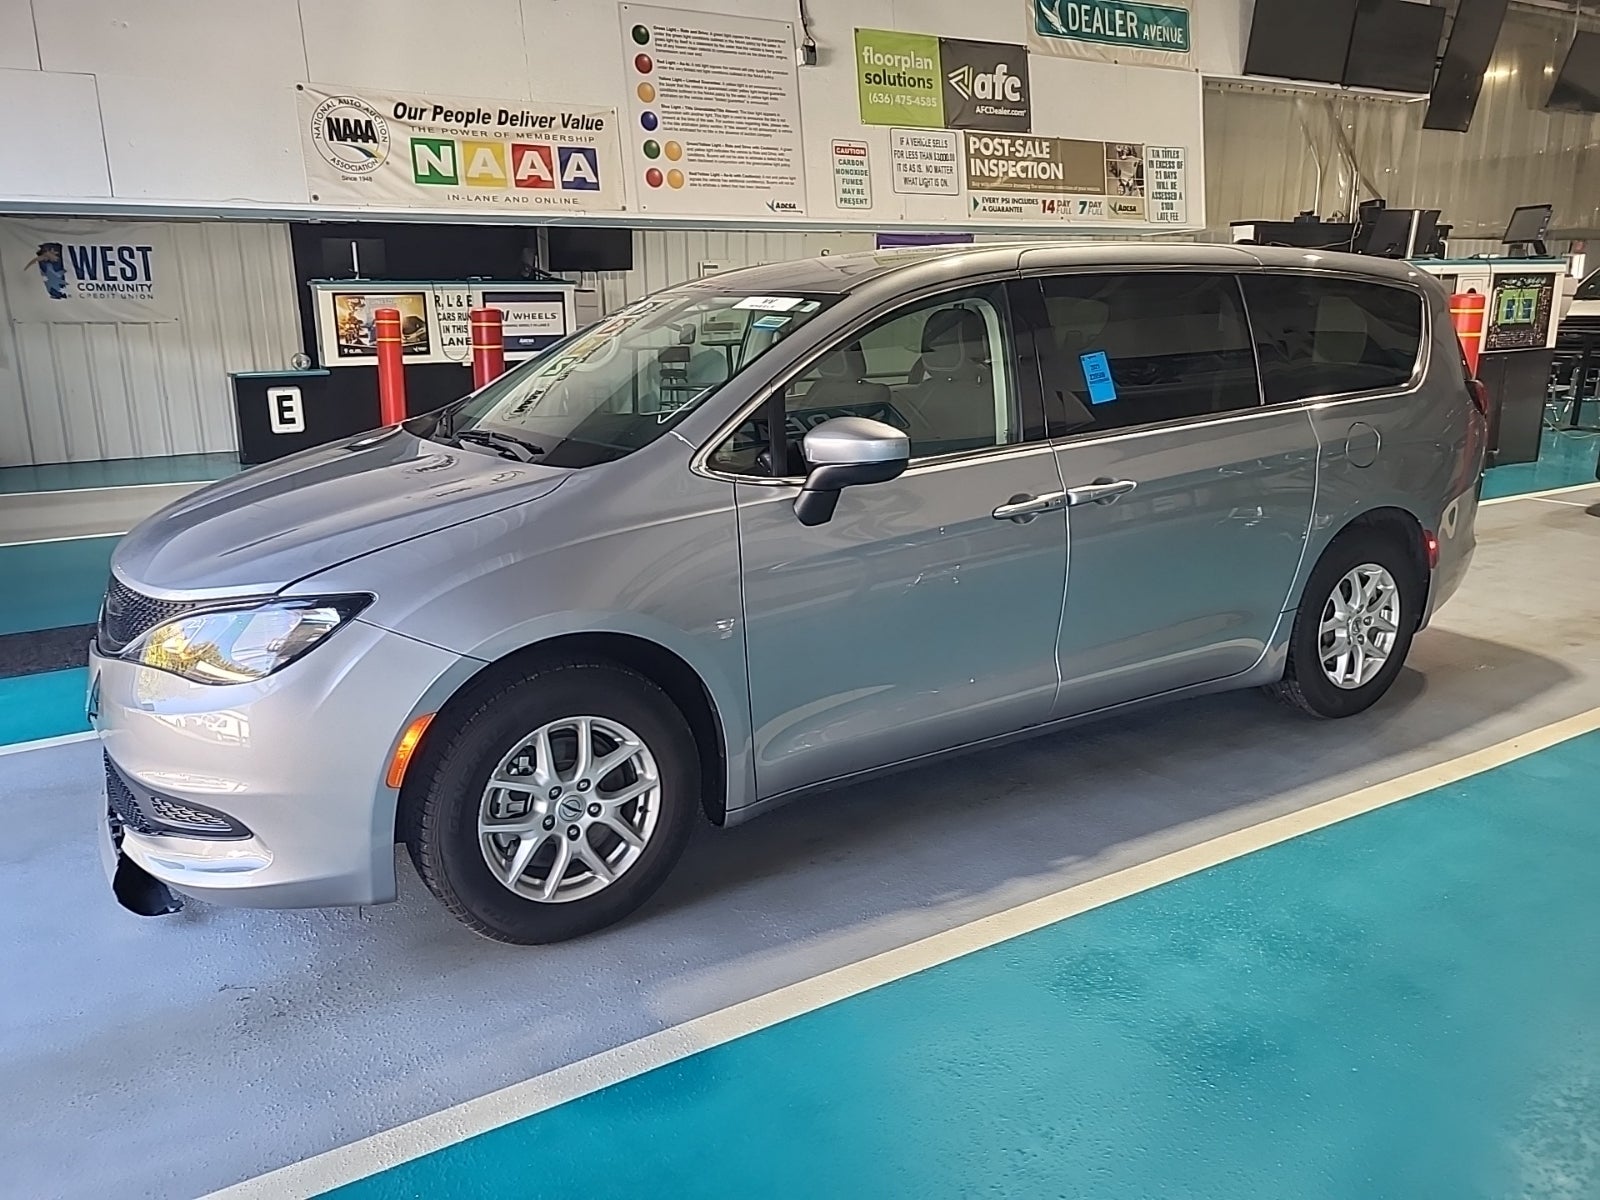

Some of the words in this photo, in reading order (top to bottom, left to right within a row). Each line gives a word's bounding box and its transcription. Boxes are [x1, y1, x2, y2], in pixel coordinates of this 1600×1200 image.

[1067, 2, 1138, 38] DEALER
[1142, 24, 1184, 44] AVENUE
[862, 46, 933, 71] floorplan
[864, 68, 934, 90] solutions
[974, 64, 1022, 102] afc
[338, 98, 362, 108] AUTO
[868, 92, 894, 106] (636)
[314, 100, 336, 140] NATIONAL
[393, 102, 428, 120] Our
[432, 104, 492, 128] People
[496, 109, 556, 128] Deliver
[560, 113, 604, 131] Value
[326, 116, 379, 144] NAAA
[364, 107, 388, 143] AUCTION
[410, 126, 436, 134] THE
[441, 128, 488, 137] POWER
[516, 132, 595, 142] MEMBERSHIP
[932, 139, 948, 148] SELLS
[969, 136, 1050, 158] POST-SALE
[836, 146, 866, 156] CAUTION
[894, 150, 904, 158] FOR
[906, 150, 918, 160] LESS
[919, 152, 932, 160] THAN
[330, 157, 379, 172] ASSOCIATION
[838, 158, 864, 166] CARBON
[926, 164, 932, 174] NO
[934, 166, 954, 174] MATTER
[970, 158, 1064, 180] INSPECTION
[836, 168, 868, 176] MONOXIDE
[447, 194, 499, 202] IN-LANE
[504, 195, 529, 204] AND
[535, 196, 579, 205] ONLINE
[1042, 200, 1056, 214] 14
[1078, 200, 1088, 214] 7
[68, 246, 152, 282] WEST
[77, 282, 152, 292] COMMUNITY
[446, 294, 453, 307] L
[456, 294, 463, 307] &
[466, 294, 473, 308] E
[438, 312, 456, 321] CARS
[457, 312, 472, 321] RUN
[442, 325, 450, 333] IN
[452, 325, 468, 333] THIS
[442, 337, 472, 346] LANE
[277, 395, 296, 426] E
